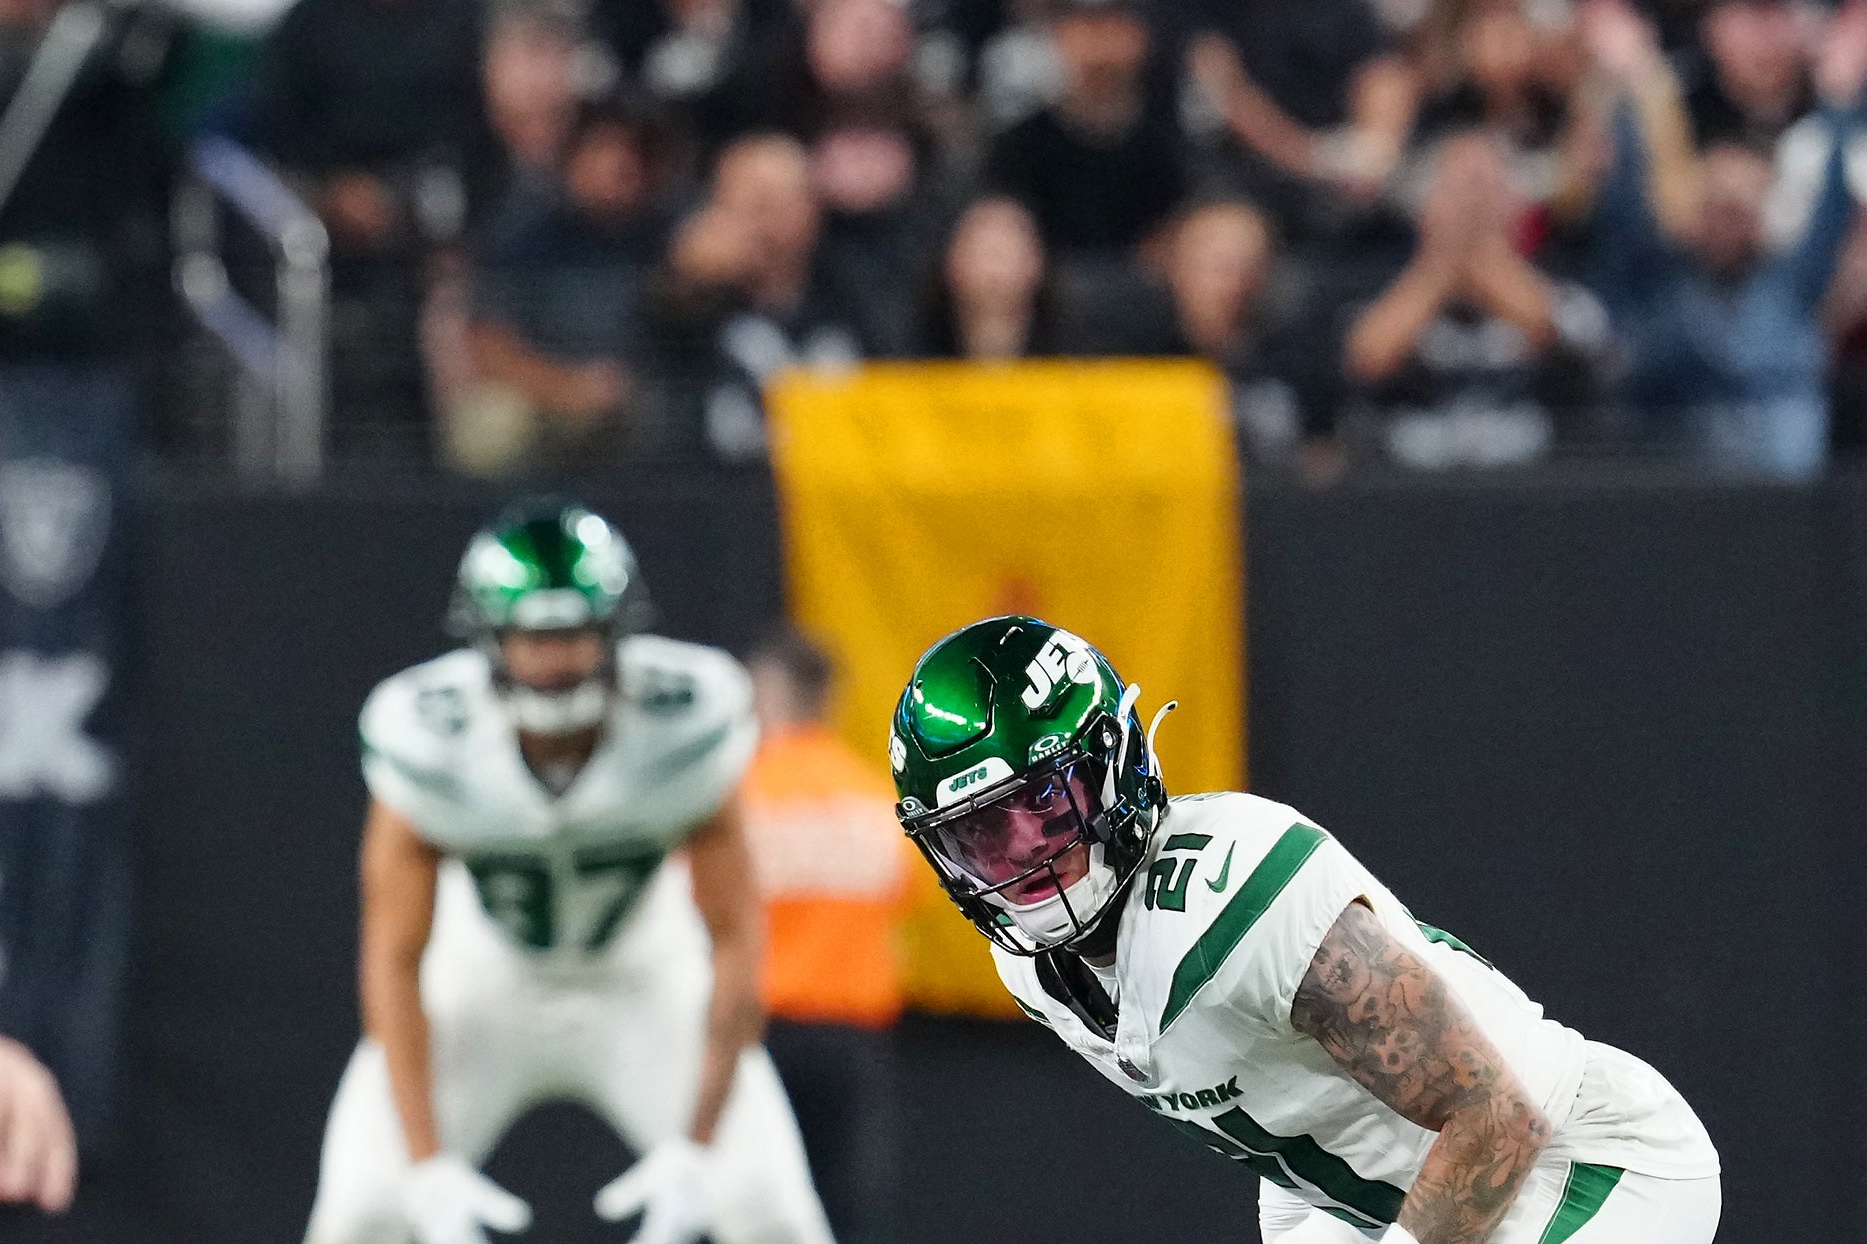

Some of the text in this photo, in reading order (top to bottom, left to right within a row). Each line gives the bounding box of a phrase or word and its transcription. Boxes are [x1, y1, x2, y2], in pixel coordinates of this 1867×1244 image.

[948, 766, 988, 792] JETS
[1144, 832, 1214, 913] 21
[1161, 1074, 1245, 1112] YORK
